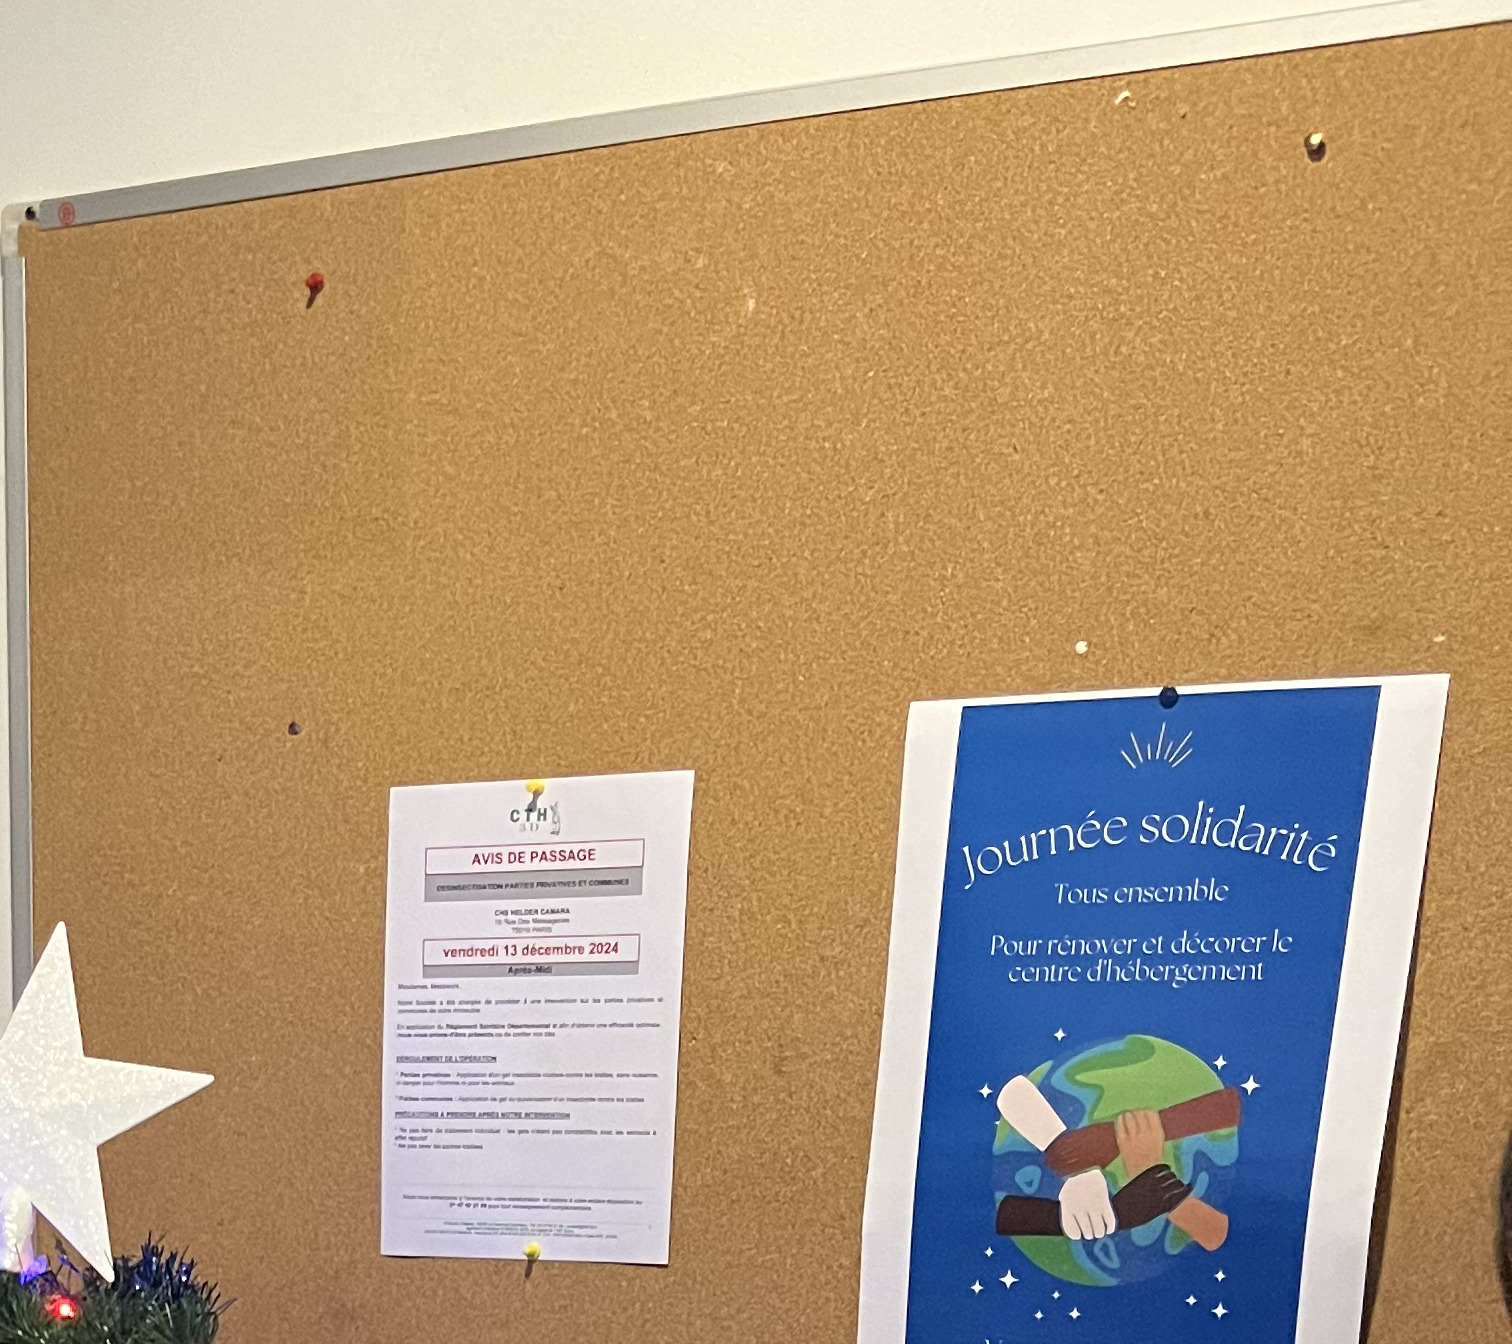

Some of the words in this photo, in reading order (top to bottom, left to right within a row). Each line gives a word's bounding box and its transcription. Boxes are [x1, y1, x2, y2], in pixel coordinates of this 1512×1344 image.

[472, 852, 503, 866] AVIS
[508, 851, 525, 864] DE
[531, 849, 597, 863] PASSAGE
[961, 810, 1129, 889] Journée
[1139, 800, 1338, 872] solidarité
[1054, 882, 1109, 905] Tous
[1114, 878, 1230, 904] ensemble
[443, 944, 499, 958] vendredi
[504, 944, 517, 956] 13
[522, 942, 584, 956] décembre
[589, 941, 619, 955] 2024
[990, 934, 1043, 957] Pour
[1046, 935, 1138, 955] rénover
[1142, 935, 1165, 954] et
[1171, 930, 1267, 954] décorer
[1271, 929, 1293, 953] le
[507, 966, 553, 975] Après-Midi
[1008, 962, 1081, 983] centre
[1087, 958, 1264, 989] d'hébergement
